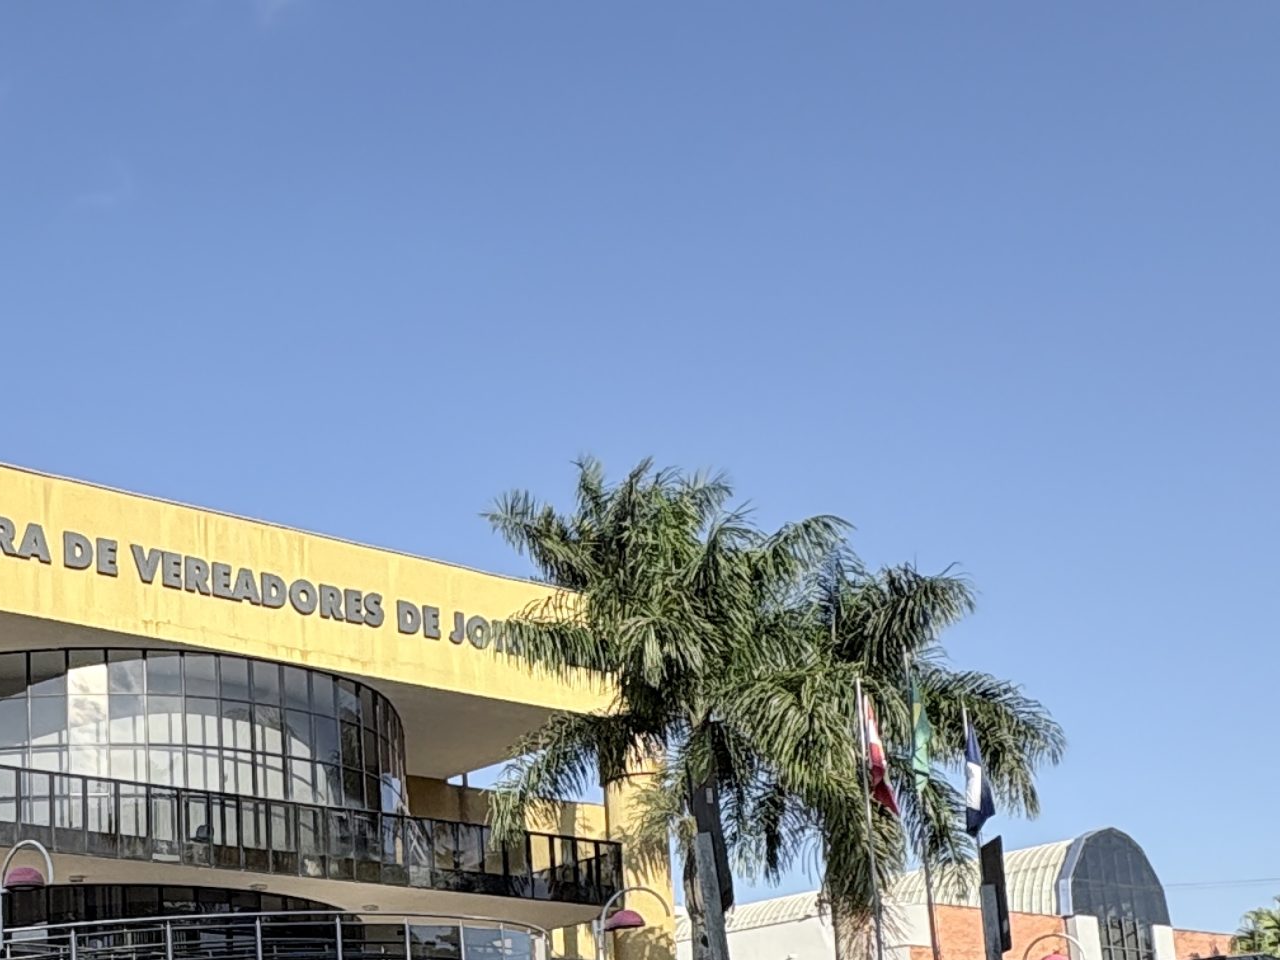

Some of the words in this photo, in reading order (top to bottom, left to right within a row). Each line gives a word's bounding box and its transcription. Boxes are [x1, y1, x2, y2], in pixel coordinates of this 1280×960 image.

[62, 531, 119, 577] DE
[129, 544, 385, 628] VEREADORES
[396, 599, 441, 641] DE
